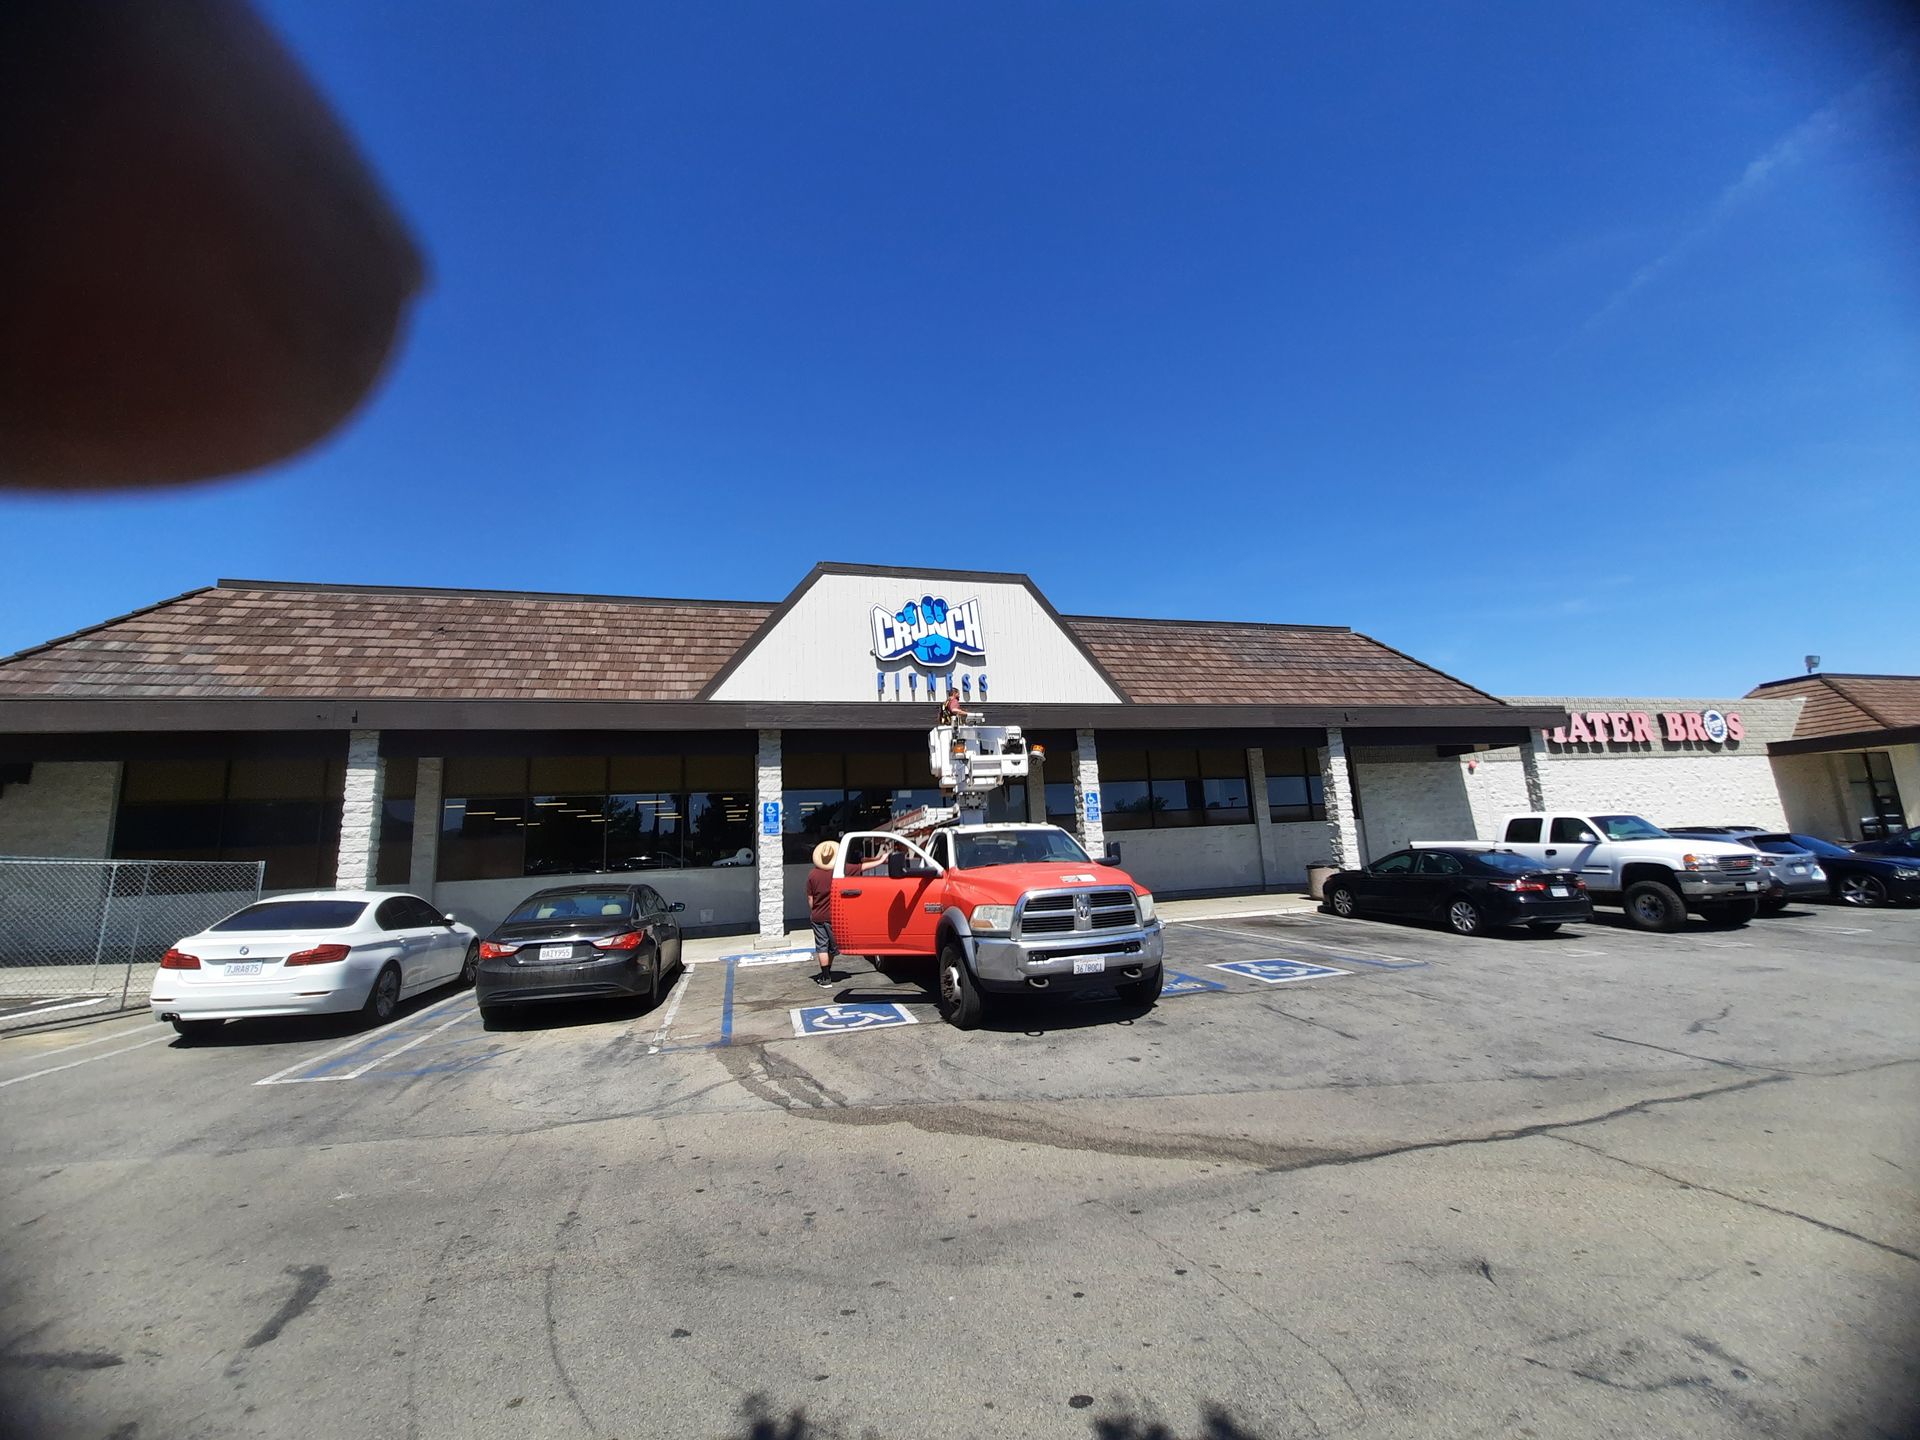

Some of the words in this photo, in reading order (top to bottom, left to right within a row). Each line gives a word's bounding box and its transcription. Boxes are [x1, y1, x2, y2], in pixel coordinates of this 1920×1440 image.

[873, 599, 985, 658] CRUNCH
[878, 672, 988, 692] FITNESS
[1542, 712, 1655, 742] ATER
[226, 964, 259, 973] 7JRA875
